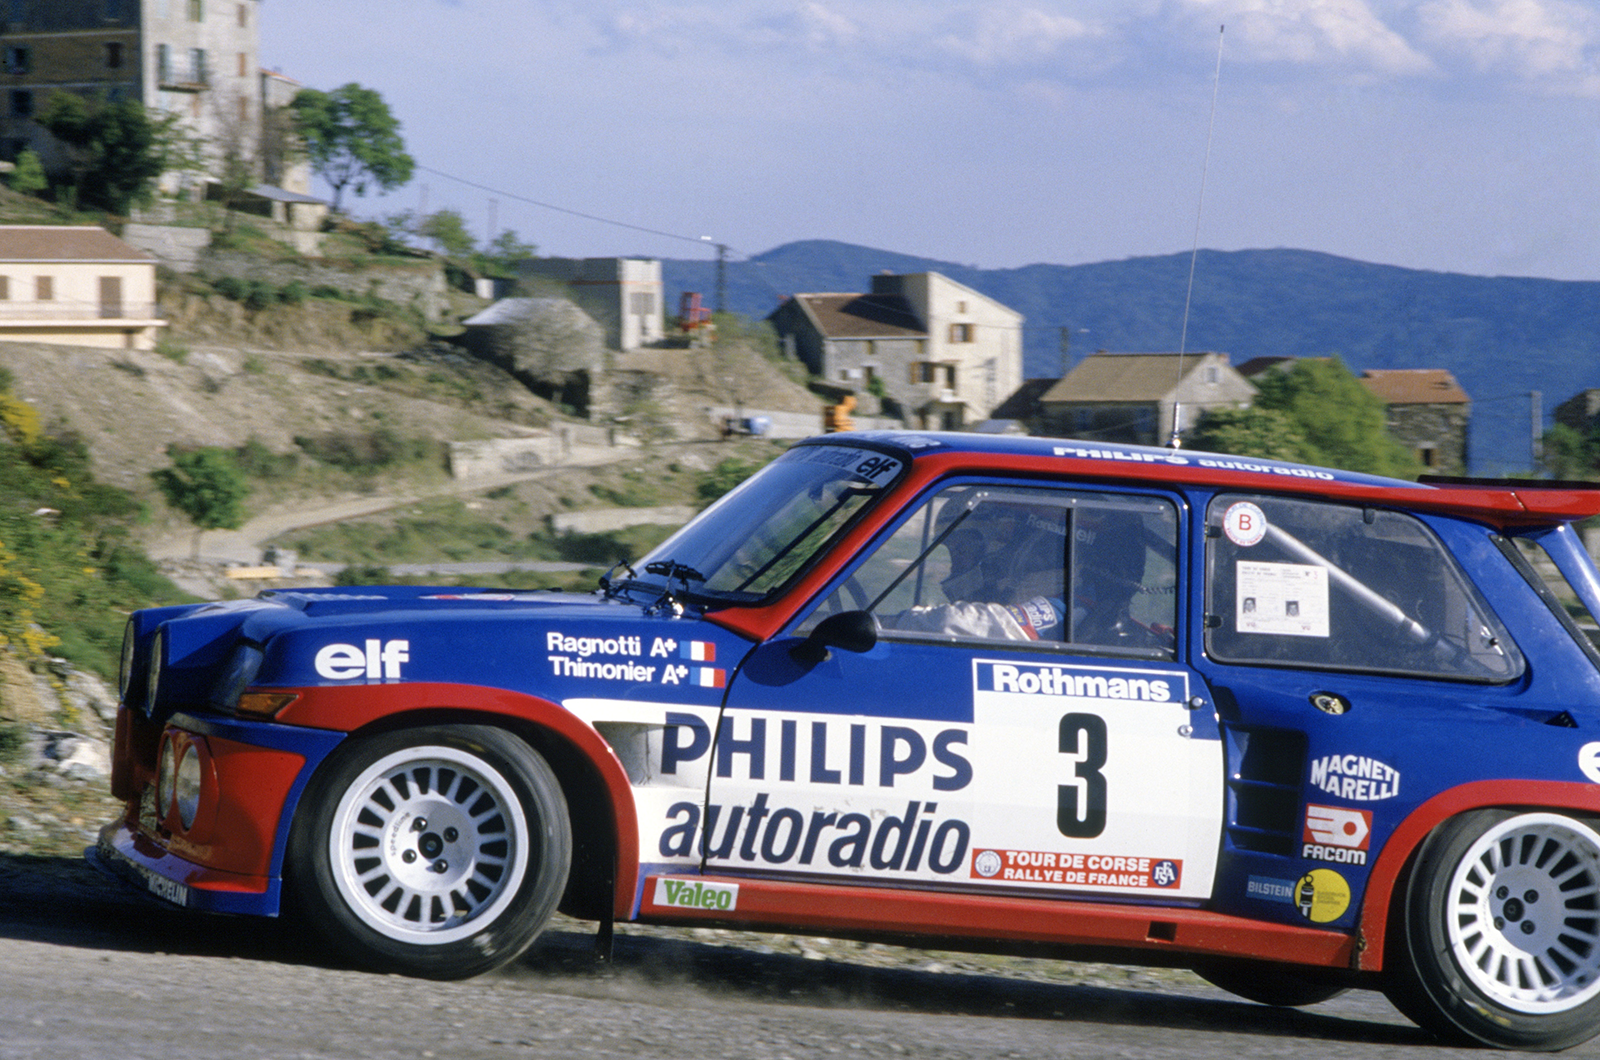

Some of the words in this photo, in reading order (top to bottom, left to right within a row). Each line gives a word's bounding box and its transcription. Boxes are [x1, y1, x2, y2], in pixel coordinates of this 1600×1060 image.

[855, 457, 898, 479] elf
[1053, 446, 1189, 465] PHILIPS
[1198, 458, 1335, 481] autoradio
[1239, 513, 1252, 531] B
[314, 639, 409, 679] elf
[547, 631, 641, 656] Ragnotti
[650, 637, 677, 658] A+
[548, 656, 656, 682] Thimonier
[661, 664, 689, 685] A+
[993, 664, 1171, 702] Rothmans
[660, 711, 974, 792] PHILIPS
[1057, 712, 1108, 839] 3
[1310, 754, 1401, 783] MAGNETI
[1310, 774, 1401, 801] MARELLI
[390, 812, 410, 857] speedline
[658, 793, 971, 875] autoradio
[1006, 851, 1056, 867] TOUR
[1059, 855, 1085, 869] DE
[1087, 856, 1151, 873] CORSE
[1302, 844, 1367, 865] FACOM
[1003, 868, 1064, 882] RALLYE
[1065, 872, 1087, 884] DE
[1088, 873, 1149, 887] FRANCE
[1247, 880, 1293, 897] BILSTEIN
[664, 879, 732, 910] Valeo
